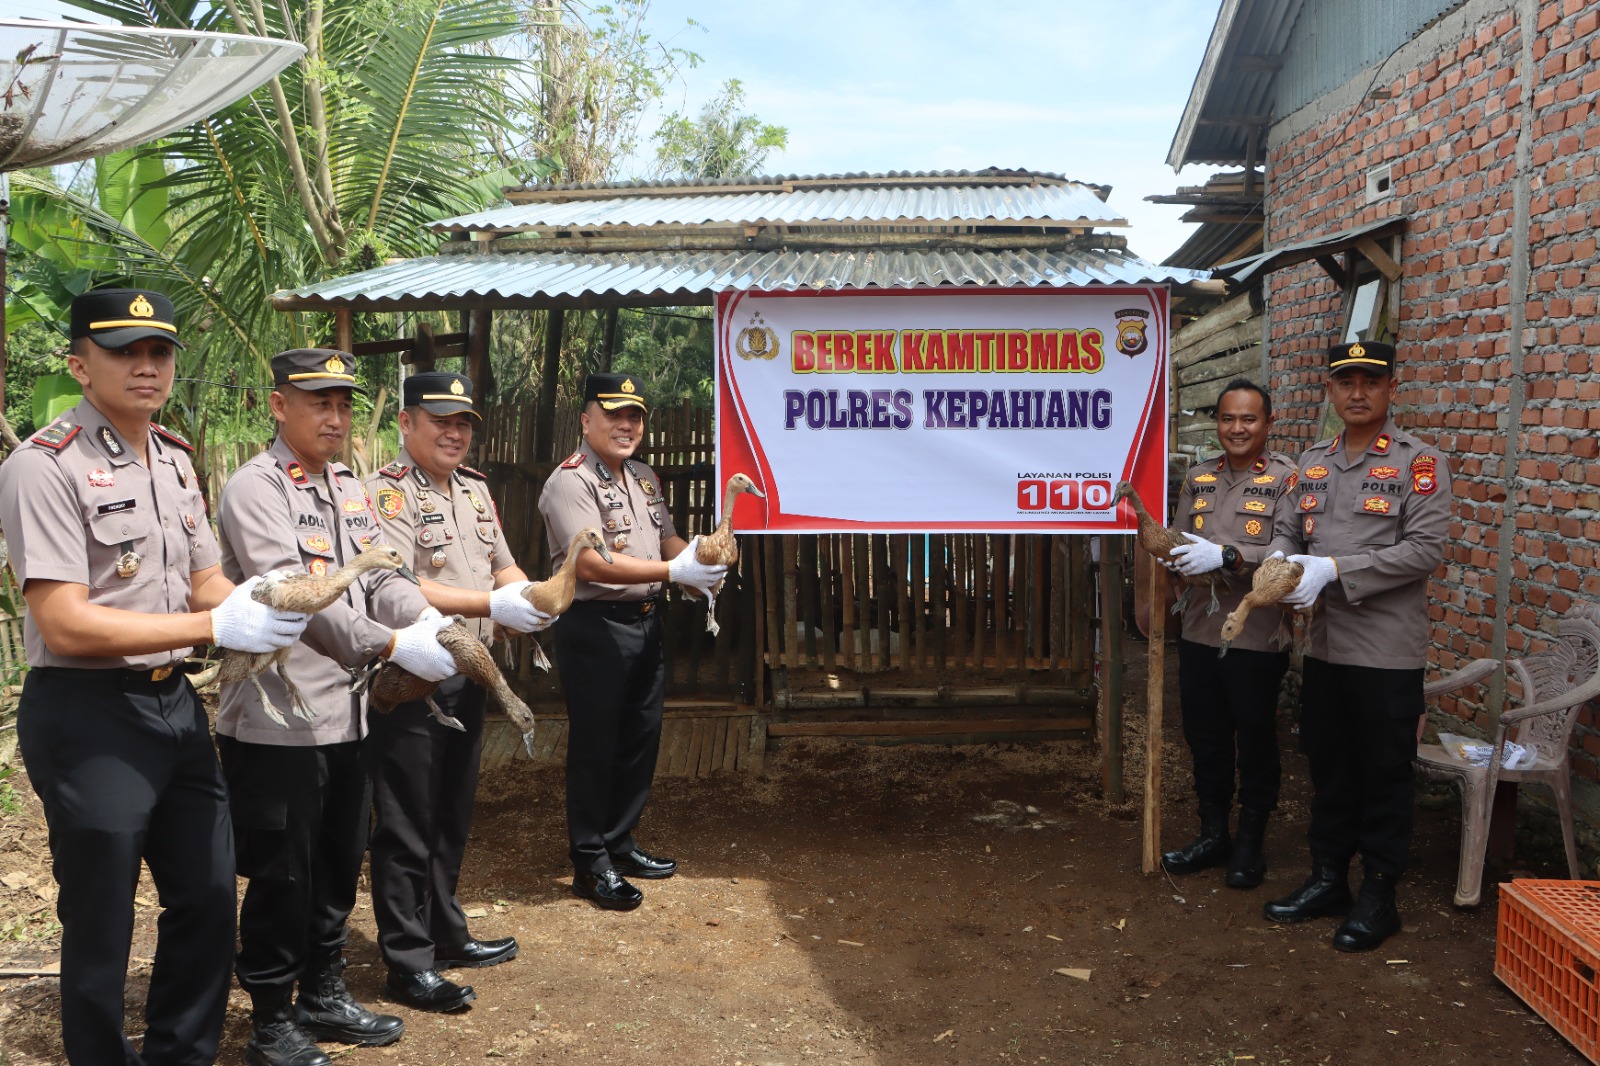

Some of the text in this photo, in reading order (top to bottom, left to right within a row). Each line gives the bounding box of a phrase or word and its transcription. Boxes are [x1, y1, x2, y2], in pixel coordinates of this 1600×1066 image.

[792, 329, 1104, 373] BEBEK KAMTIBMAS
[783, 388, 1112, 430] POLRES KEPAHIANG
[1021, 484, 1108, 507] 110
[1242, 486, 1277, 498] POLRI
[1300, 482, 1328, 492] TULUS
[1361, 482, 1402, 494] POLRI
